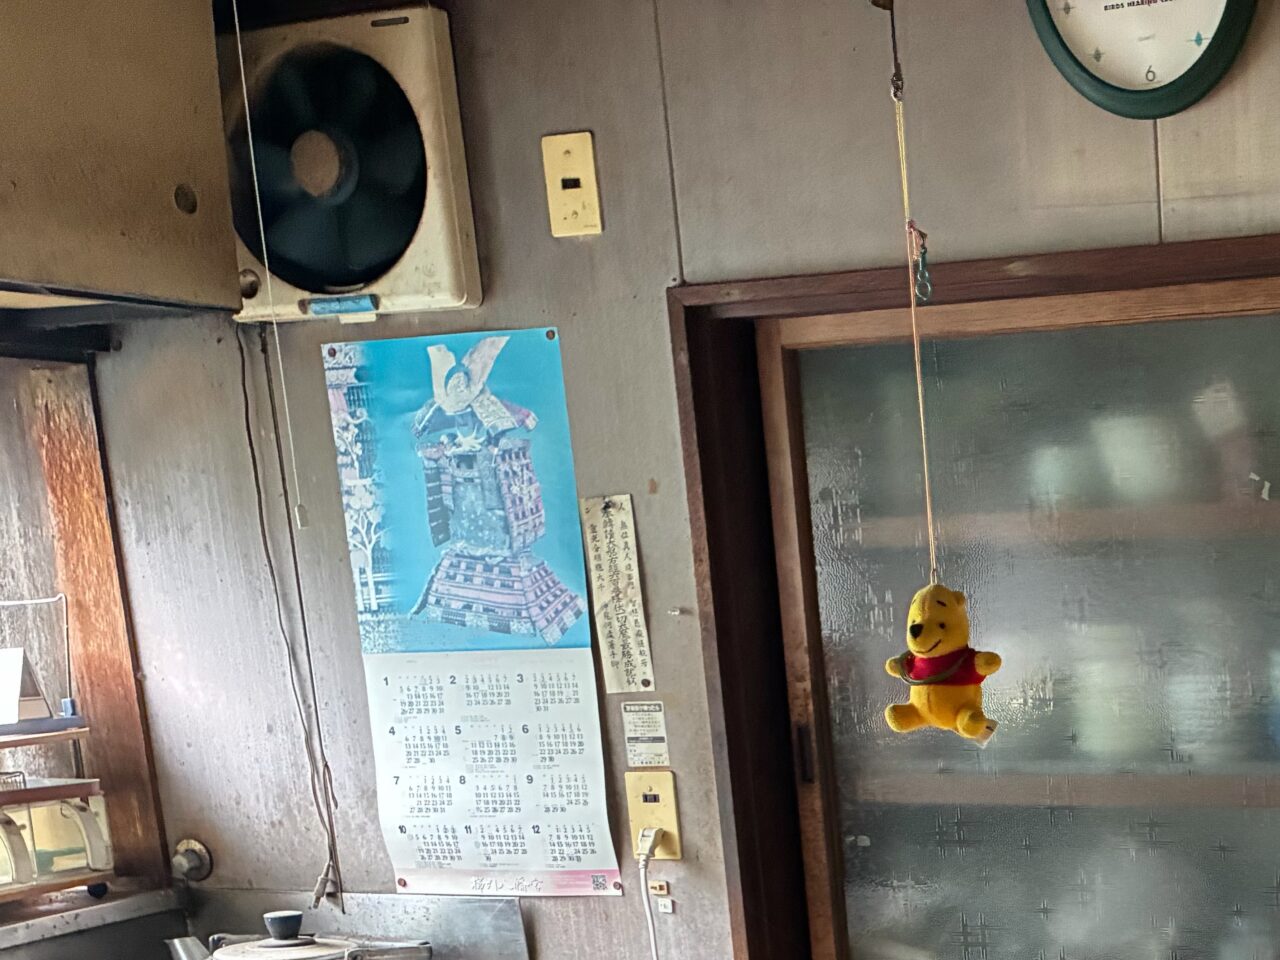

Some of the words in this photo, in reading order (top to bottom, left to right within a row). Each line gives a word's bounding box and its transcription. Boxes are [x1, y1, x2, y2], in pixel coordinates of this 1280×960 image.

[1145, 66, 1156, 82] 6
[384, 677, 388, 686] 1
[450, 675, 456, 684] 2
[517, 673, 524, 683] 3
[389, 726, 395, 736] 4
[455, 725, 461, 735] 5
[522, 724, 529, 734] 6
[393, 776, 400, 784] 7
[459, 775, 466, 784] 8
[526, 774, 533, 784] 9
[398, 825, 406, 834] 10
[464, 825, 472, 834] 11
[532, 825, 540, 834] 12
